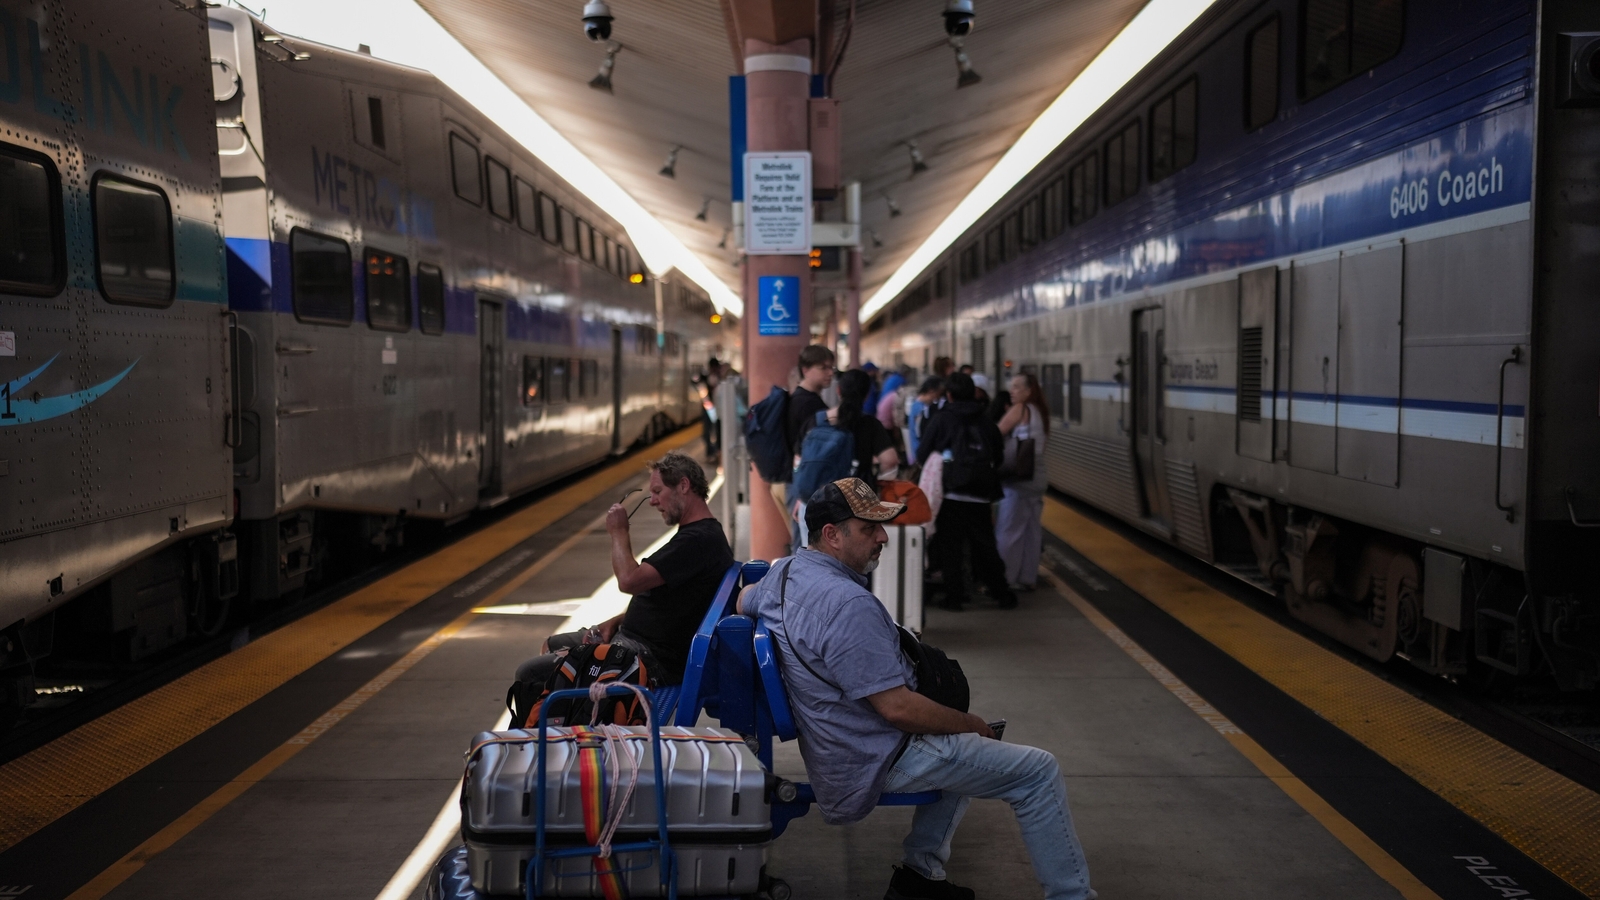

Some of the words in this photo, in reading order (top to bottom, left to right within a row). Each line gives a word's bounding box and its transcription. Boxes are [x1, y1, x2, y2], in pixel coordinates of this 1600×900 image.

[761, 163, 793, 171] Metrolink
[1389, 186, 1429, 219] 6406
[1437, 156, 1503, 207] Coach
[752, 204, 783, 213] Metrolink
[1195, 359, 1219, 380] Beach
[1, 382, 16, 419] 1
[287, 711, 351, 744] PLEASE
[1201, 716, 1244, 734] LINE
[1452, 855, 1537, 900] PLEA
